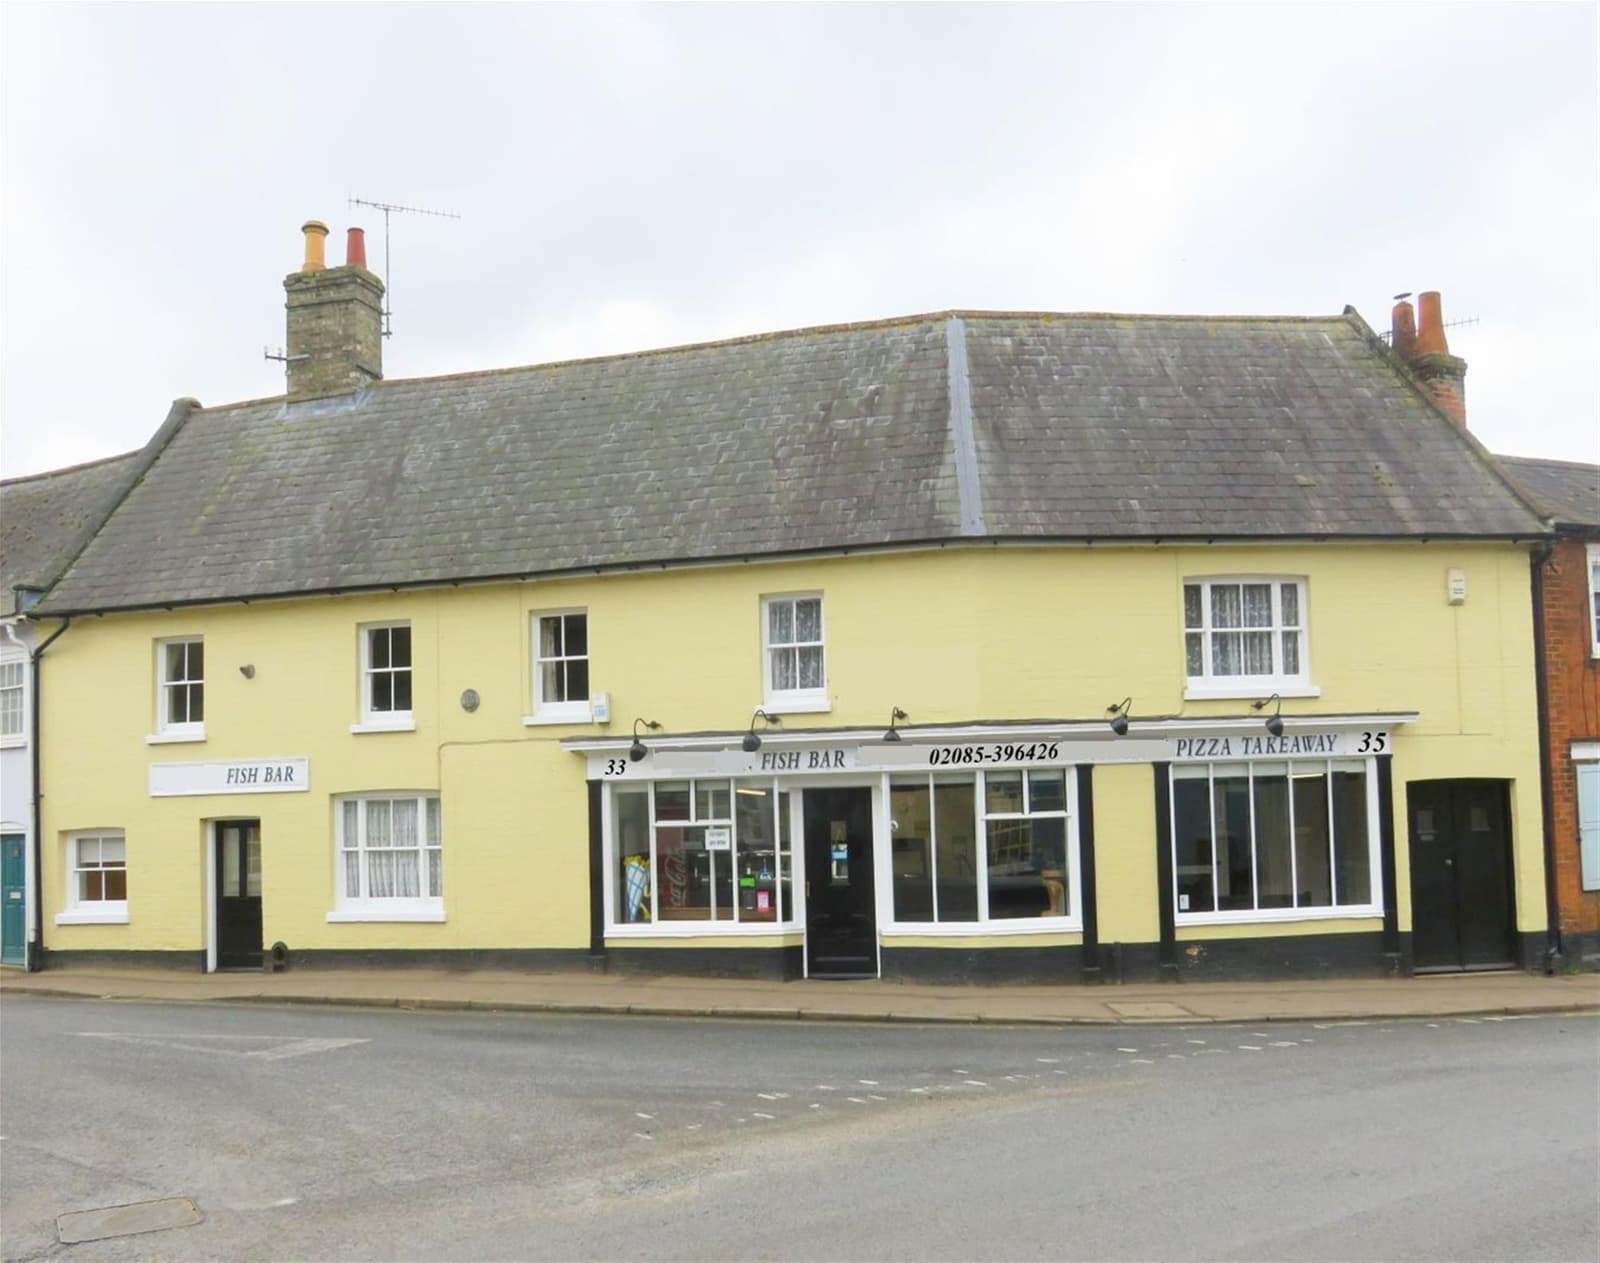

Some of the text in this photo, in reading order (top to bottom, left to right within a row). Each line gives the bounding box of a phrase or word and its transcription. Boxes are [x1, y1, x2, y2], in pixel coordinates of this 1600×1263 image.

[1176, 734, 1337, 756] PIZZA TAKEAWAY
[1357, 732, 1386, 752] 35
[761, 750, 846, 769] FISH BAR
[929, 743, 1059, 765] 02085-396426
[226, 766, 294, 784] FISH BAR
[605, 759, 626, 775] 33
